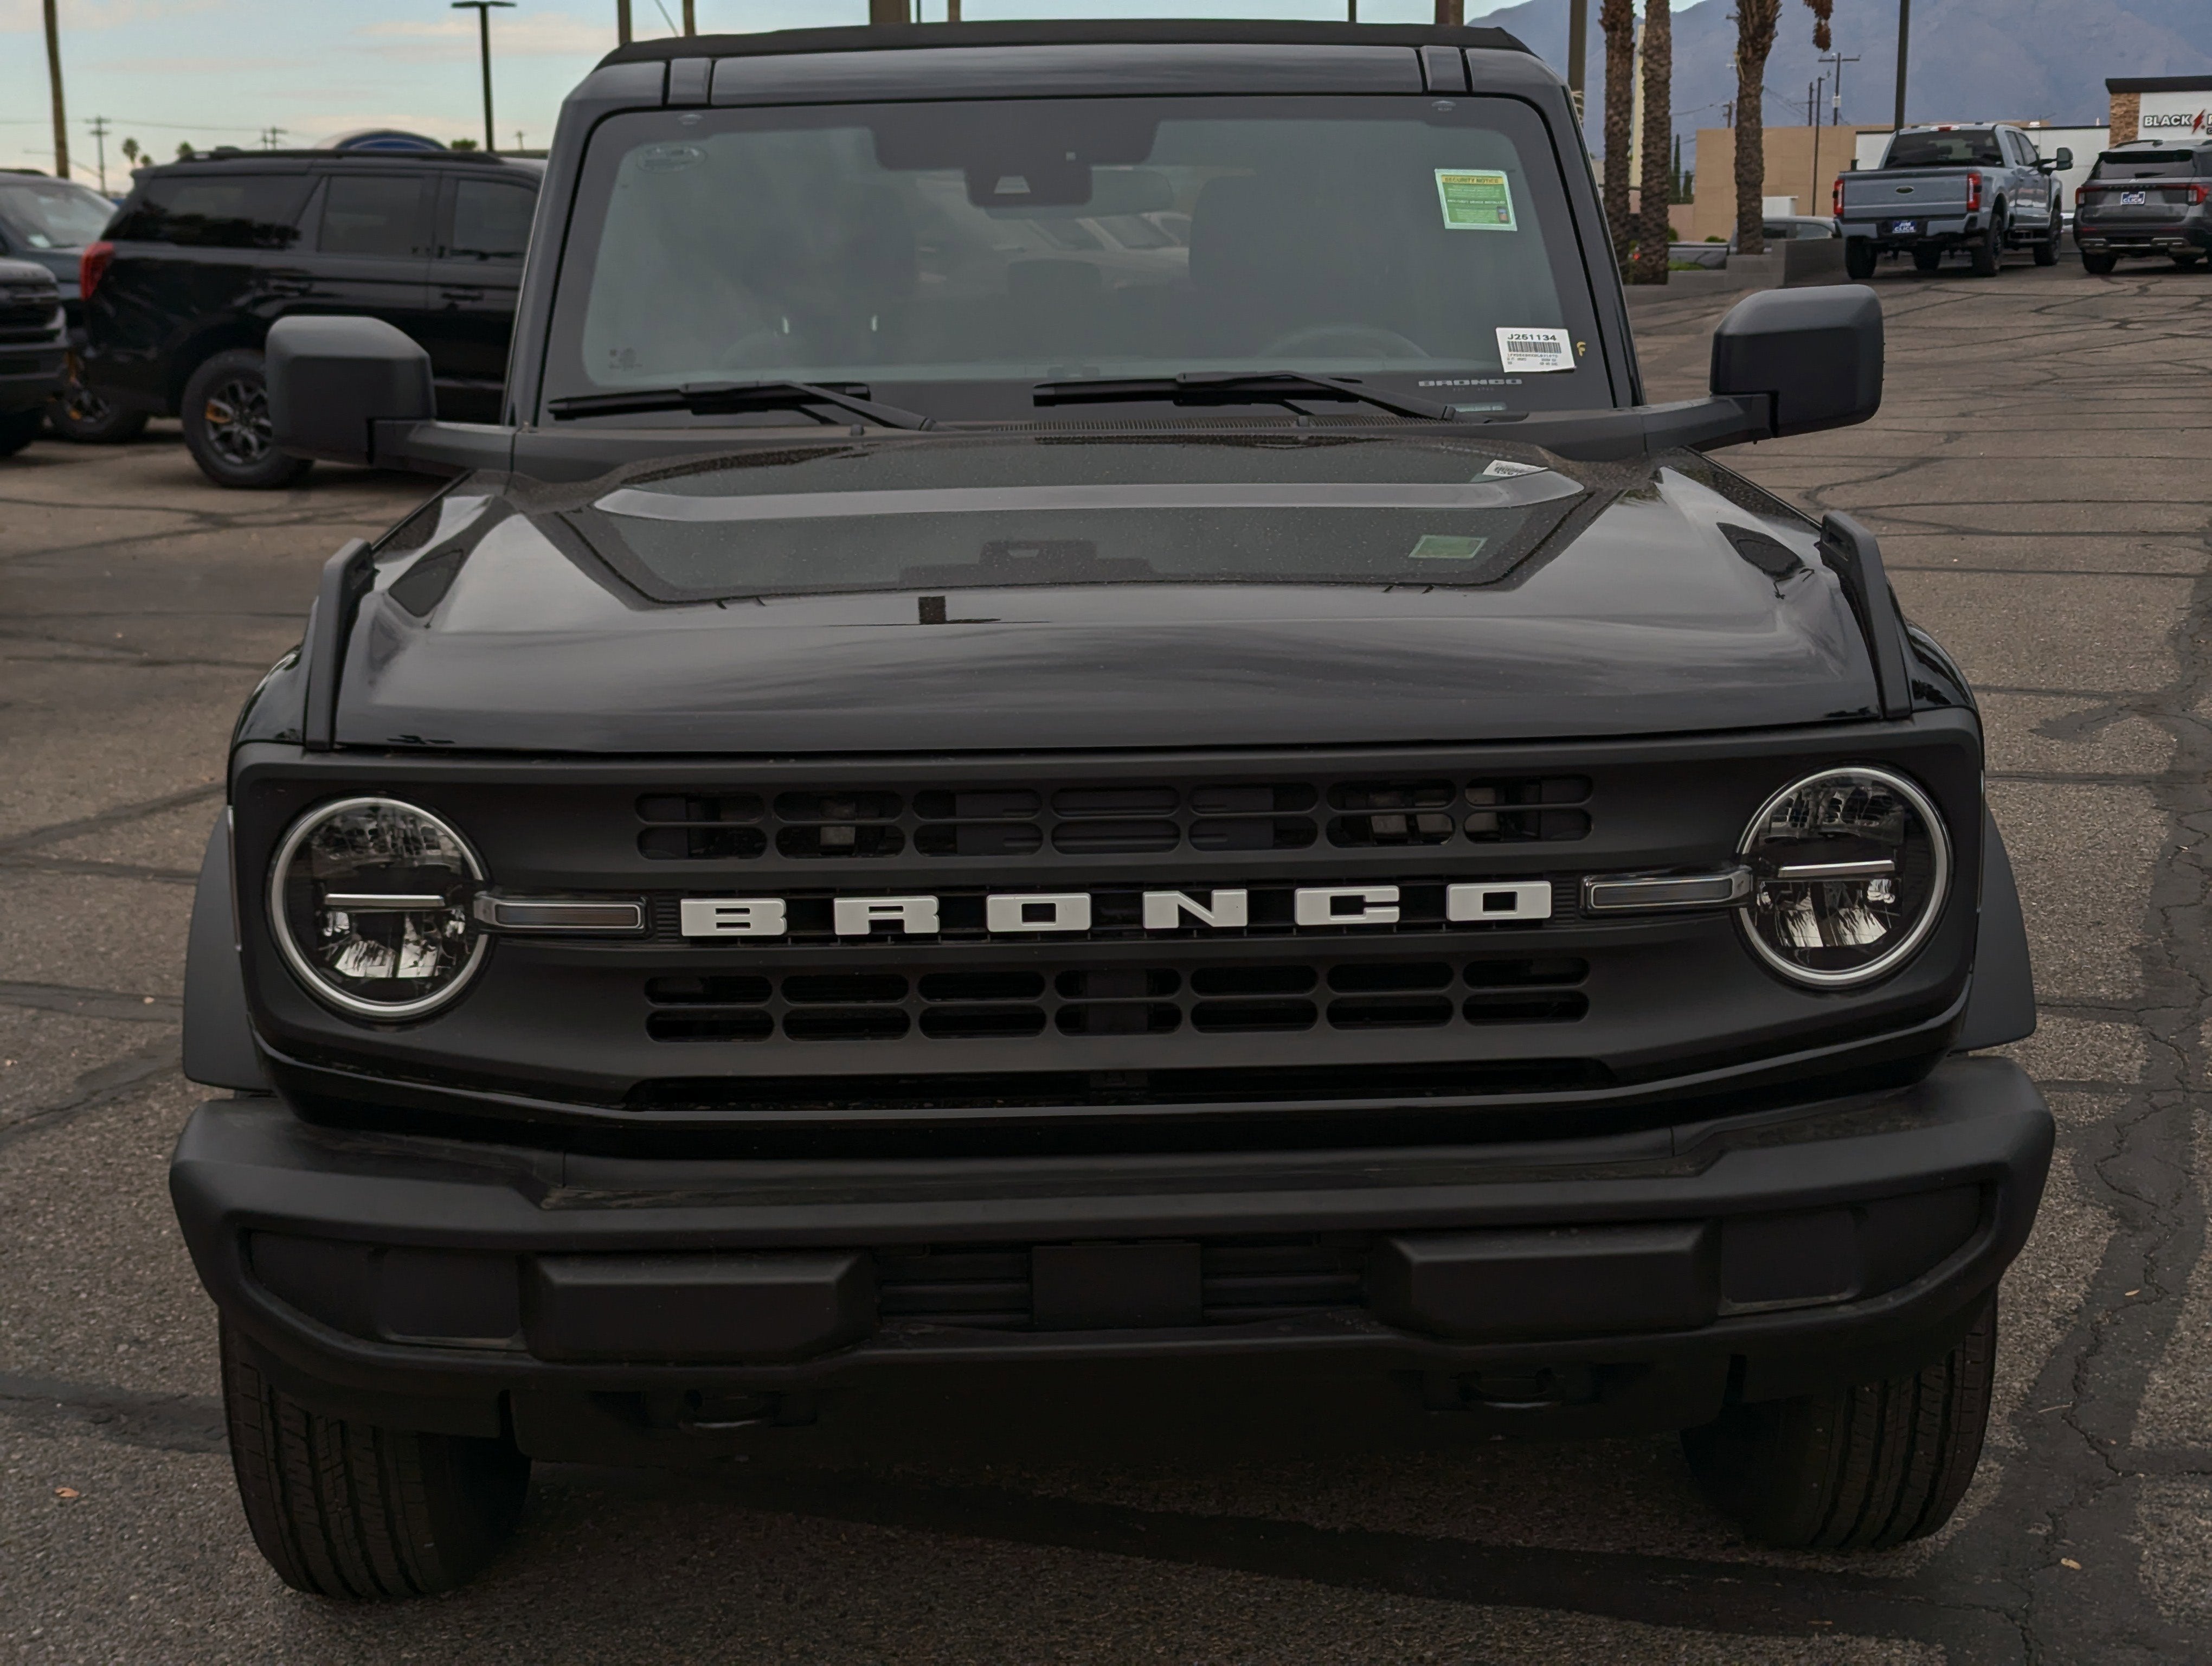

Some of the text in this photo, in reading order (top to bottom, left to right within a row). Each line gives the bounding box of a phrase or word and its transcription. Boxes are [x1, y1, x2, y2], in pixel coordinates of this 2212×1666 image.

[2144, 114, 2192, 127] BLACK
[1418, 379, 1522, 387] BRONCO
[680, 881, 1552, 937] BRONCO
